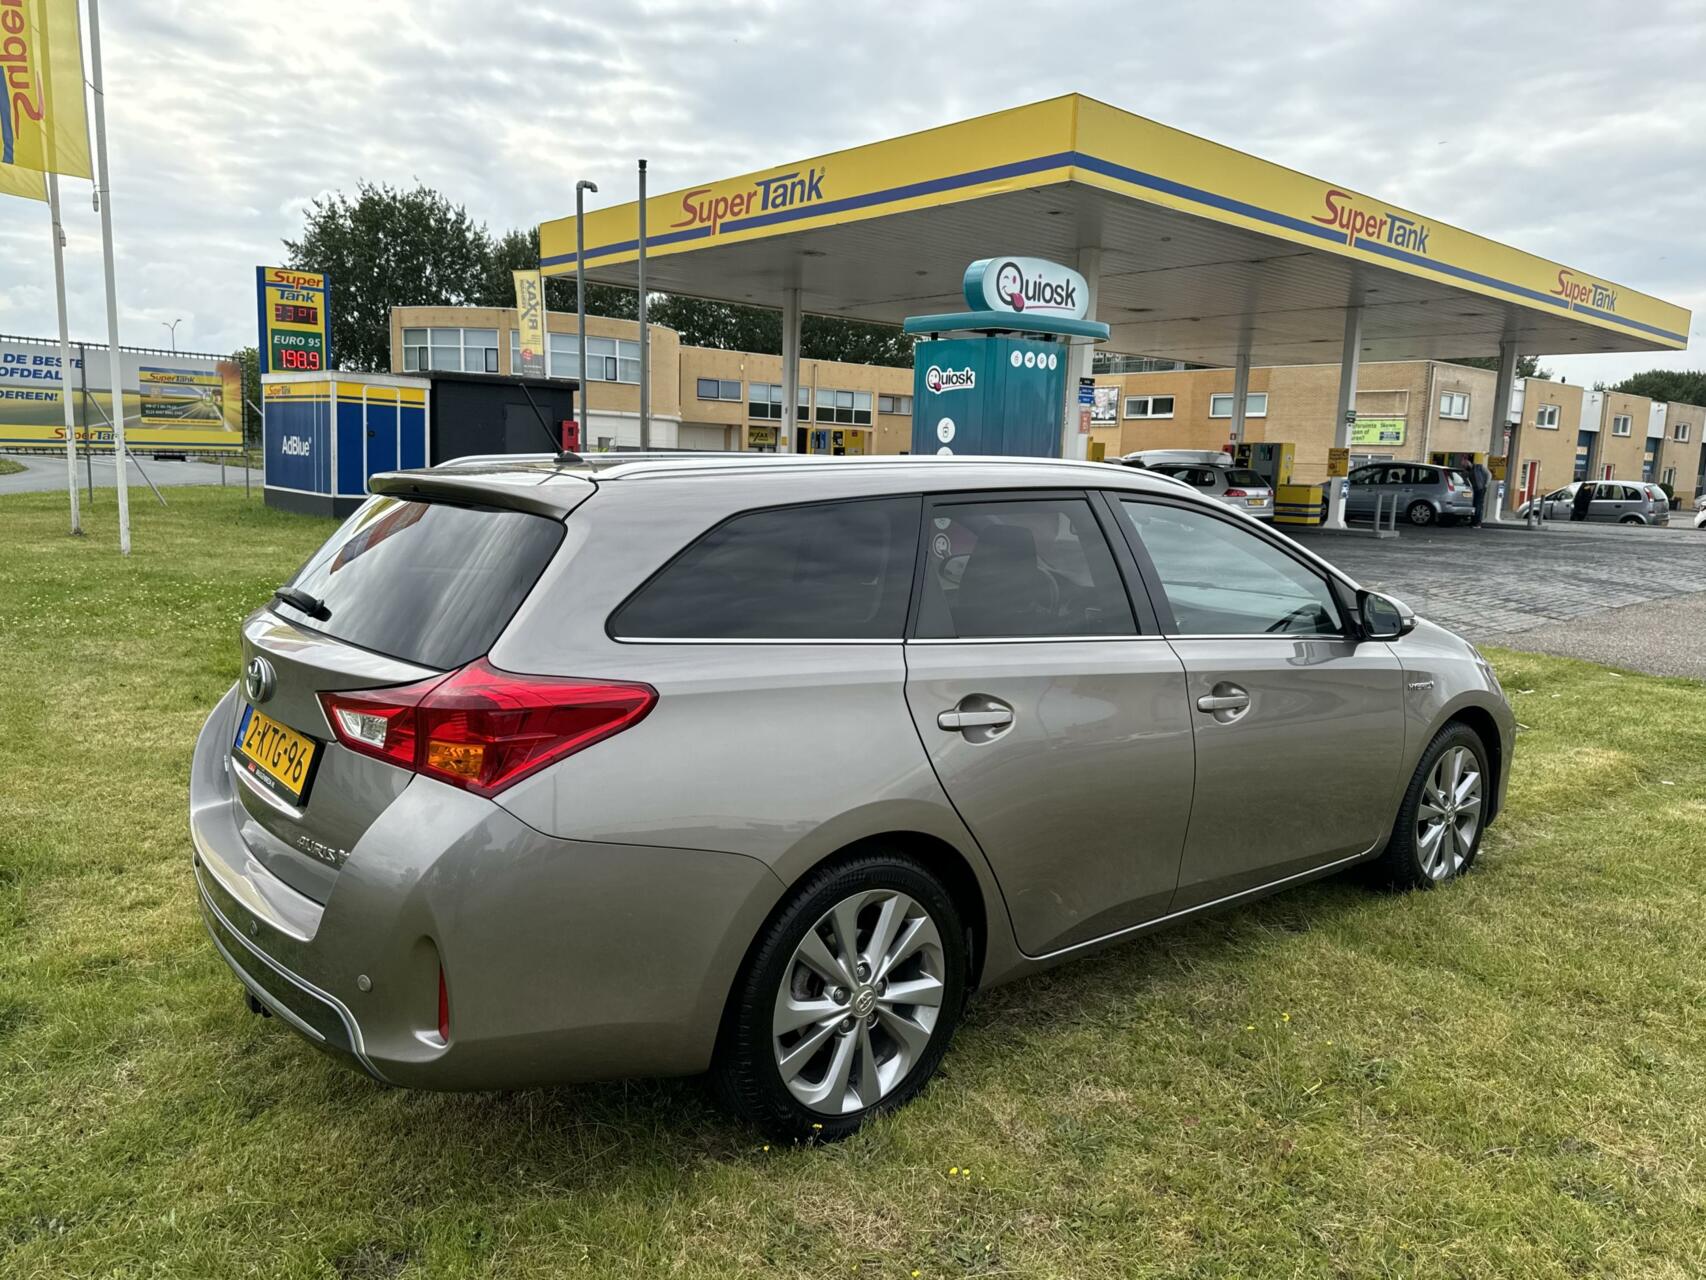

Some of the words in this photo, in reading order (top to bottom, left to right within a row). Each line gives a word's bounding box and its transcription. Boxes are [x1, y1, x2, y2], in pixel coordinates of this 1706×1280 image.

[267, 271, 323, 289] Super
[996, 261, 1076, 312] Quiosk
[276, 289, 315, 303] Tank
[273, 335, 305, 346] EURO
[308, 338, 321, 347] 95
[3, 353, 27, 364] DE
[281, 349, 320, 370] 198.9
[927, 367, 974, 392] Quiosk
[282, 435, 310, 456] AdBlue
[246, 715, 307, 784] 2-KTG-96
